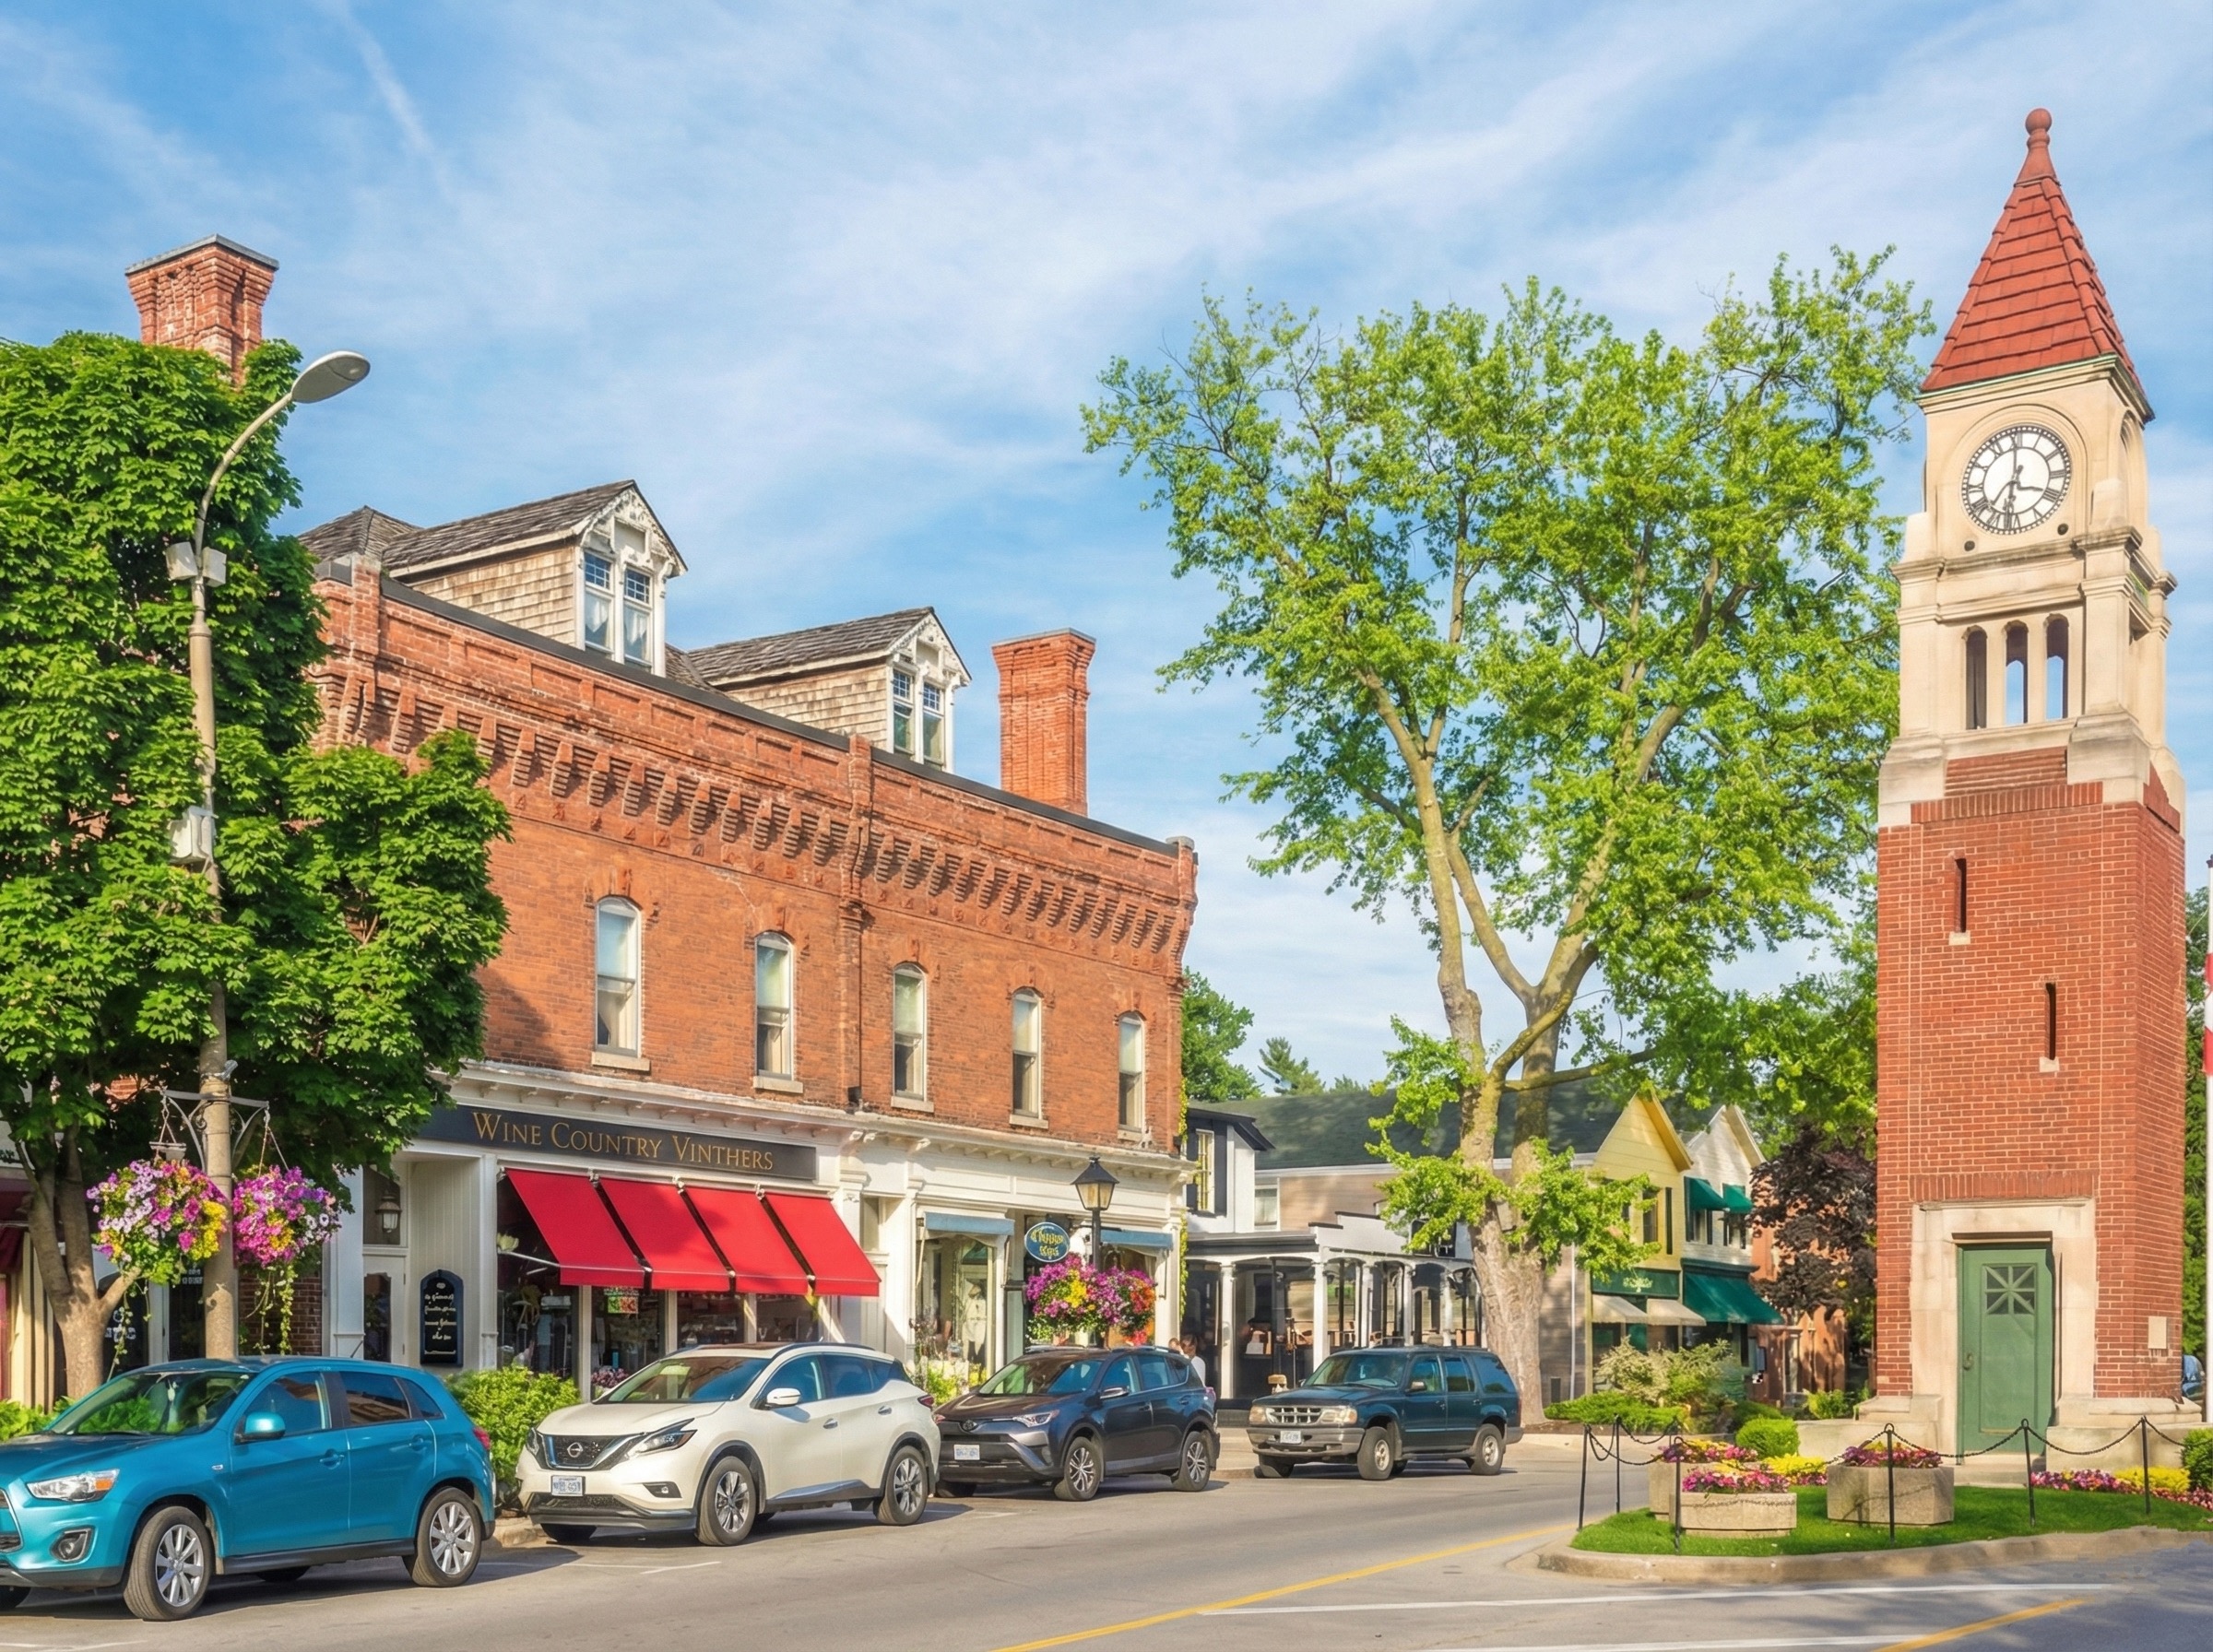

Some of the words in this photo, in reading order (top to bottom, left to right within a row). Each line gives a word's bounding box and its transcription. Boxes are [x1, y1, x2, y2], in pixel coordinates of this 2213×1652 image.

[472, 1112, 542, 1146] WINE
[551, 1122, 662, 1159] COUNTRY
[672, 1135, 774, 1170] VINTHERS
